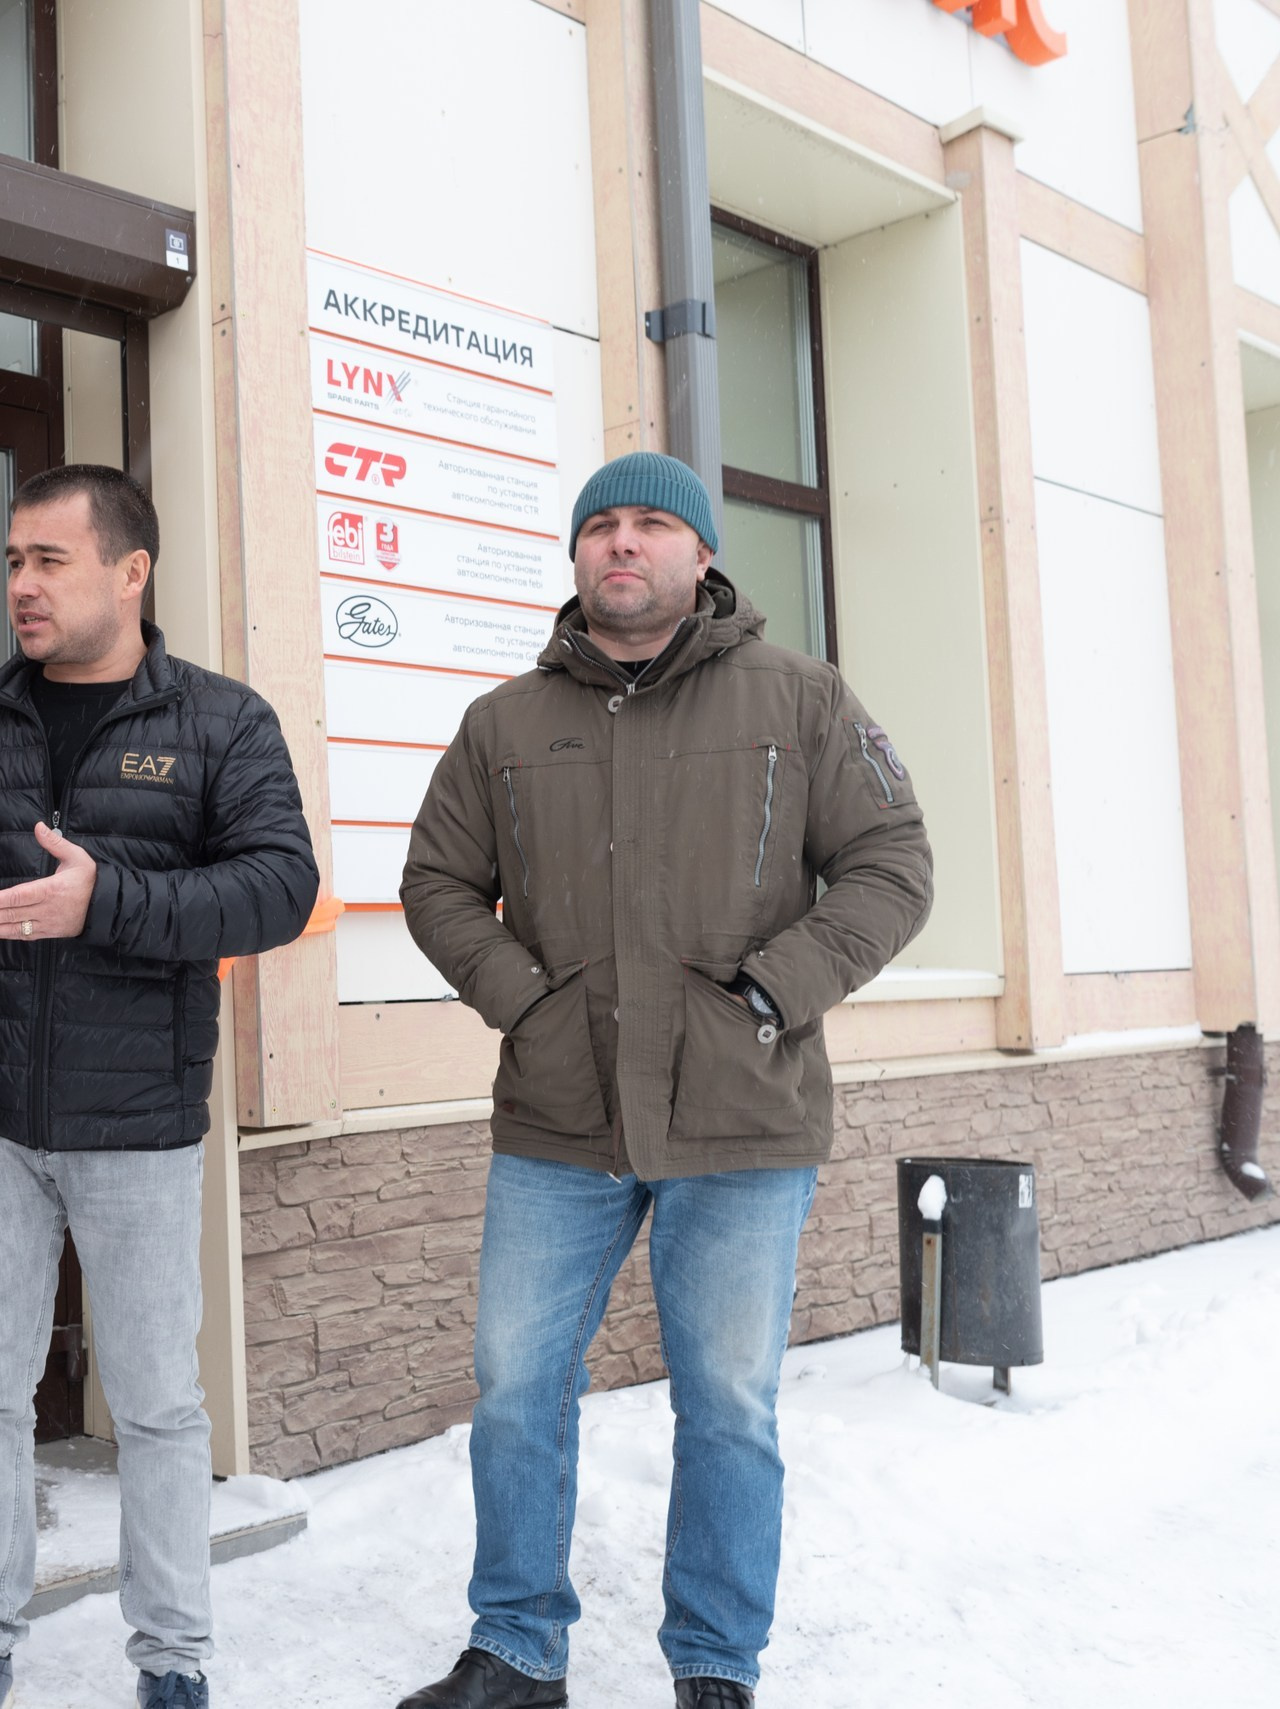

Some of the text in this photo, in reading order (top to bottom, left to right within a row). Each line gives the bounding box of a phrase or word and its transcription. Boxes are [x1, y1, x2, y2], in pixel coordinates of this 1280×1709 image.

[323, 289, 534, 368] АККРЕДИТАЦИЯ
[327, 358, 411, 406] LYNX
[327, 392, 380, 410] SPARE PARTS
[446, 393, 536, 423] Станция гарантийного
[423, 402, 478, 422] технического
[480, 415, 536, 435] обслуживания
[324, 442, 407, 487] CTR
[438, 460, 538, 489] Авторизованная станция
[451, 491, 539, 515] автокомпонентов CTR
[487, 485, 539, 502] по установке
[328, 512, 363, 549] febi
[379, 517, 394, 543] 3
[333, 547, 361, 560] bilstein
[457, 554, 542, 576] станция по установке
[477, 544, 542, 562] Авторизованная
[457, 568, 527, 587] автокомпонентов
[339, 602, 396, 640] Gates
[444, 614, 546, 636] Авторизованная станция
[453, 643, 524, 660] автокомпонентов
[507, 638, 546, 650] установке
[121, 752, 176, 776] EA7
